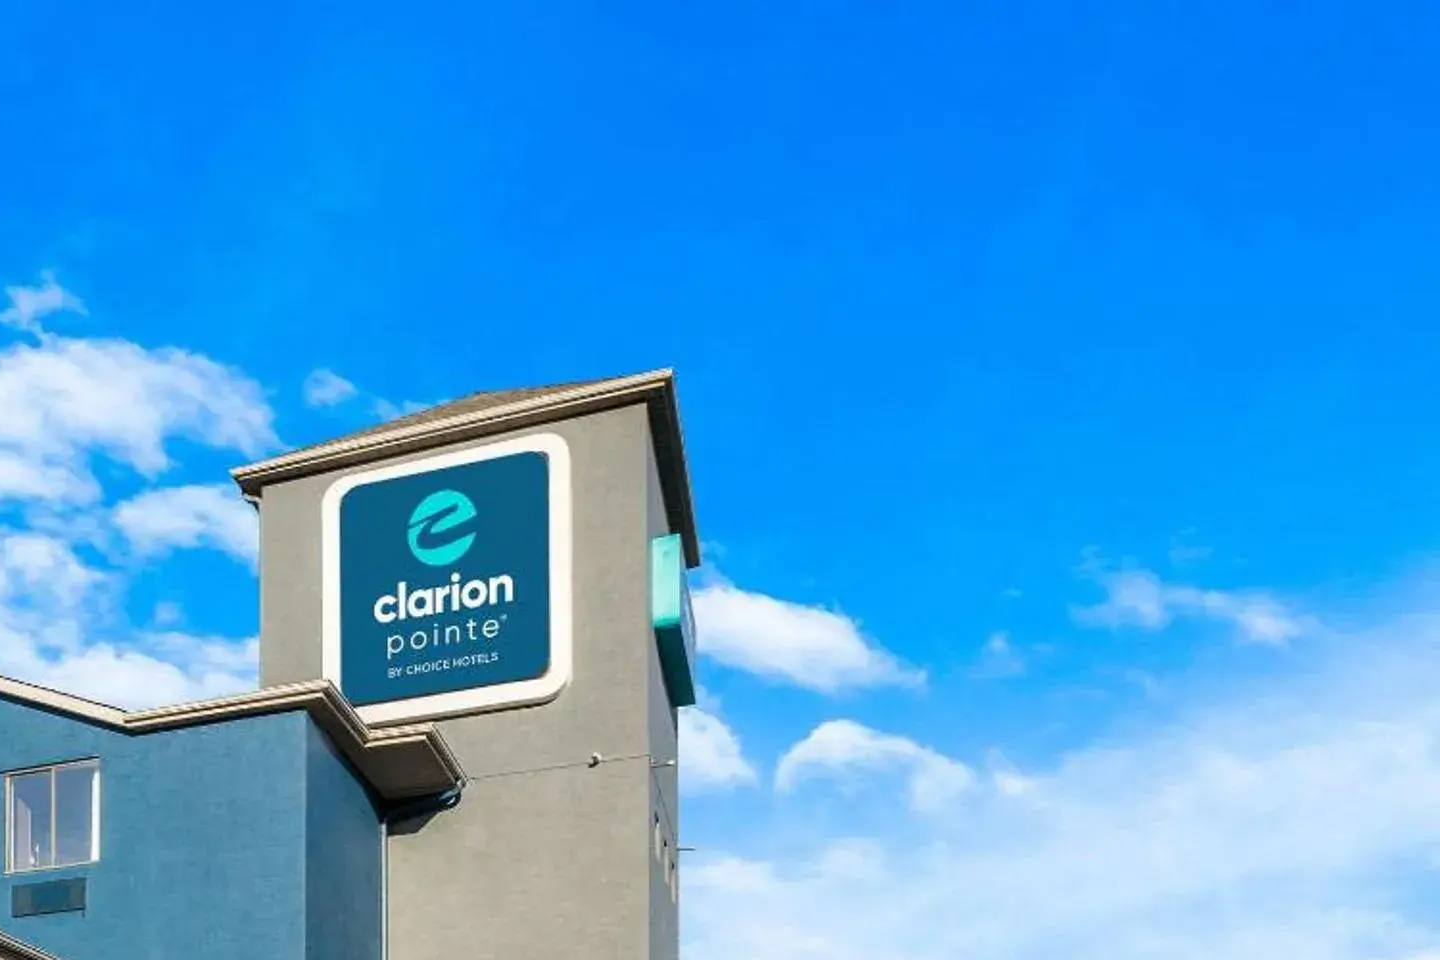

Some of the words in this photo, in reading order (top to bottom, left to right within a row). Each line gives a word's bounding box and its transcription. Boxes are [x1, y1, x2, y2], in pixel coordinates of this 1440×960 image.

[373, 572, 514, 624] clarion
[387, 617, 500, 660] pointe
[387, 666, 402, 679] BY
[406, 659, 451, 675] CHOICE
[452, 651, 499, 669] HOTELS
